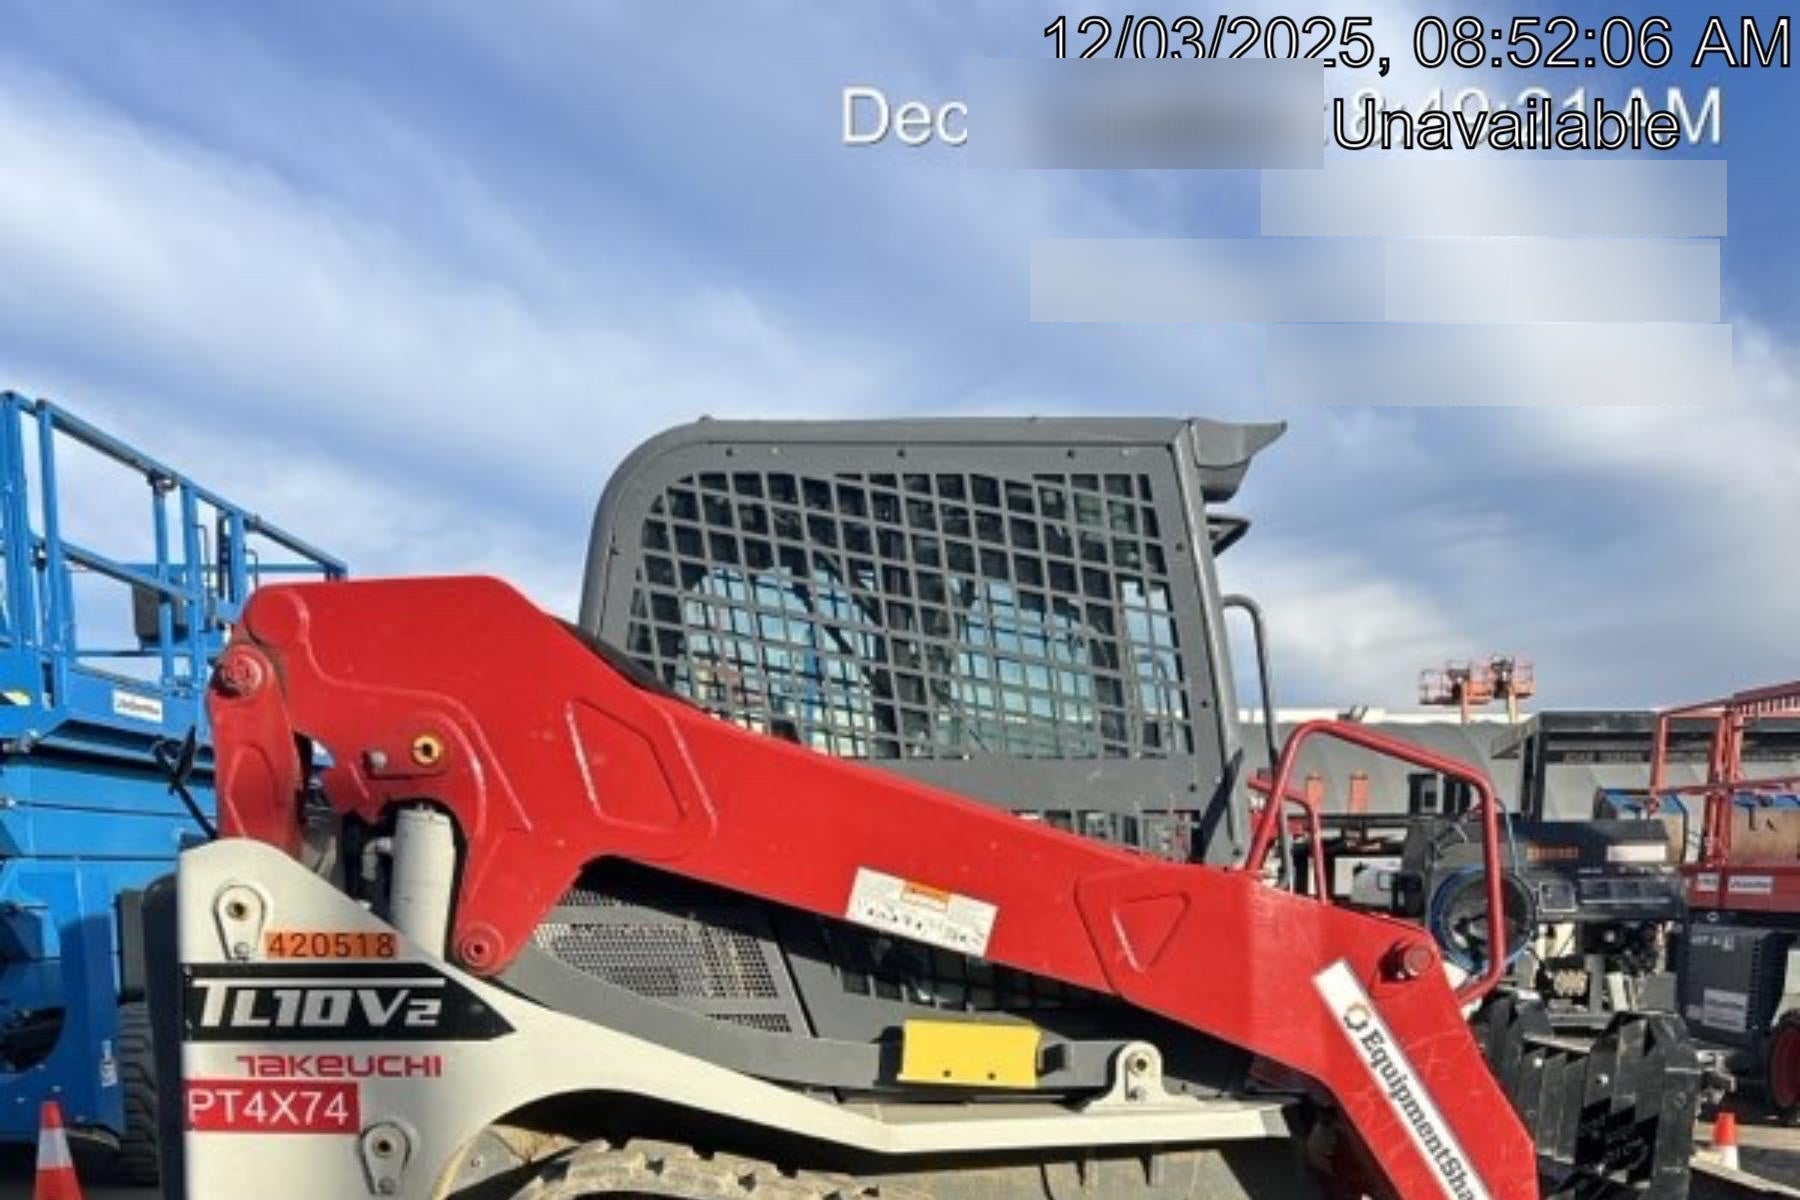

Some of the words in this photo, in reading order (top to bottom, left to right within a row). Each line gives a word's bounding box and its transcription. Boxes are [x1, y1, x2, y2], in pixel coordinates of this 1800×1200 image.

[268, 932, 395, 958] 420518
[193, 977, 445, 1028] TL10V2
[187, 1088, 349, 1126] PT4X74
